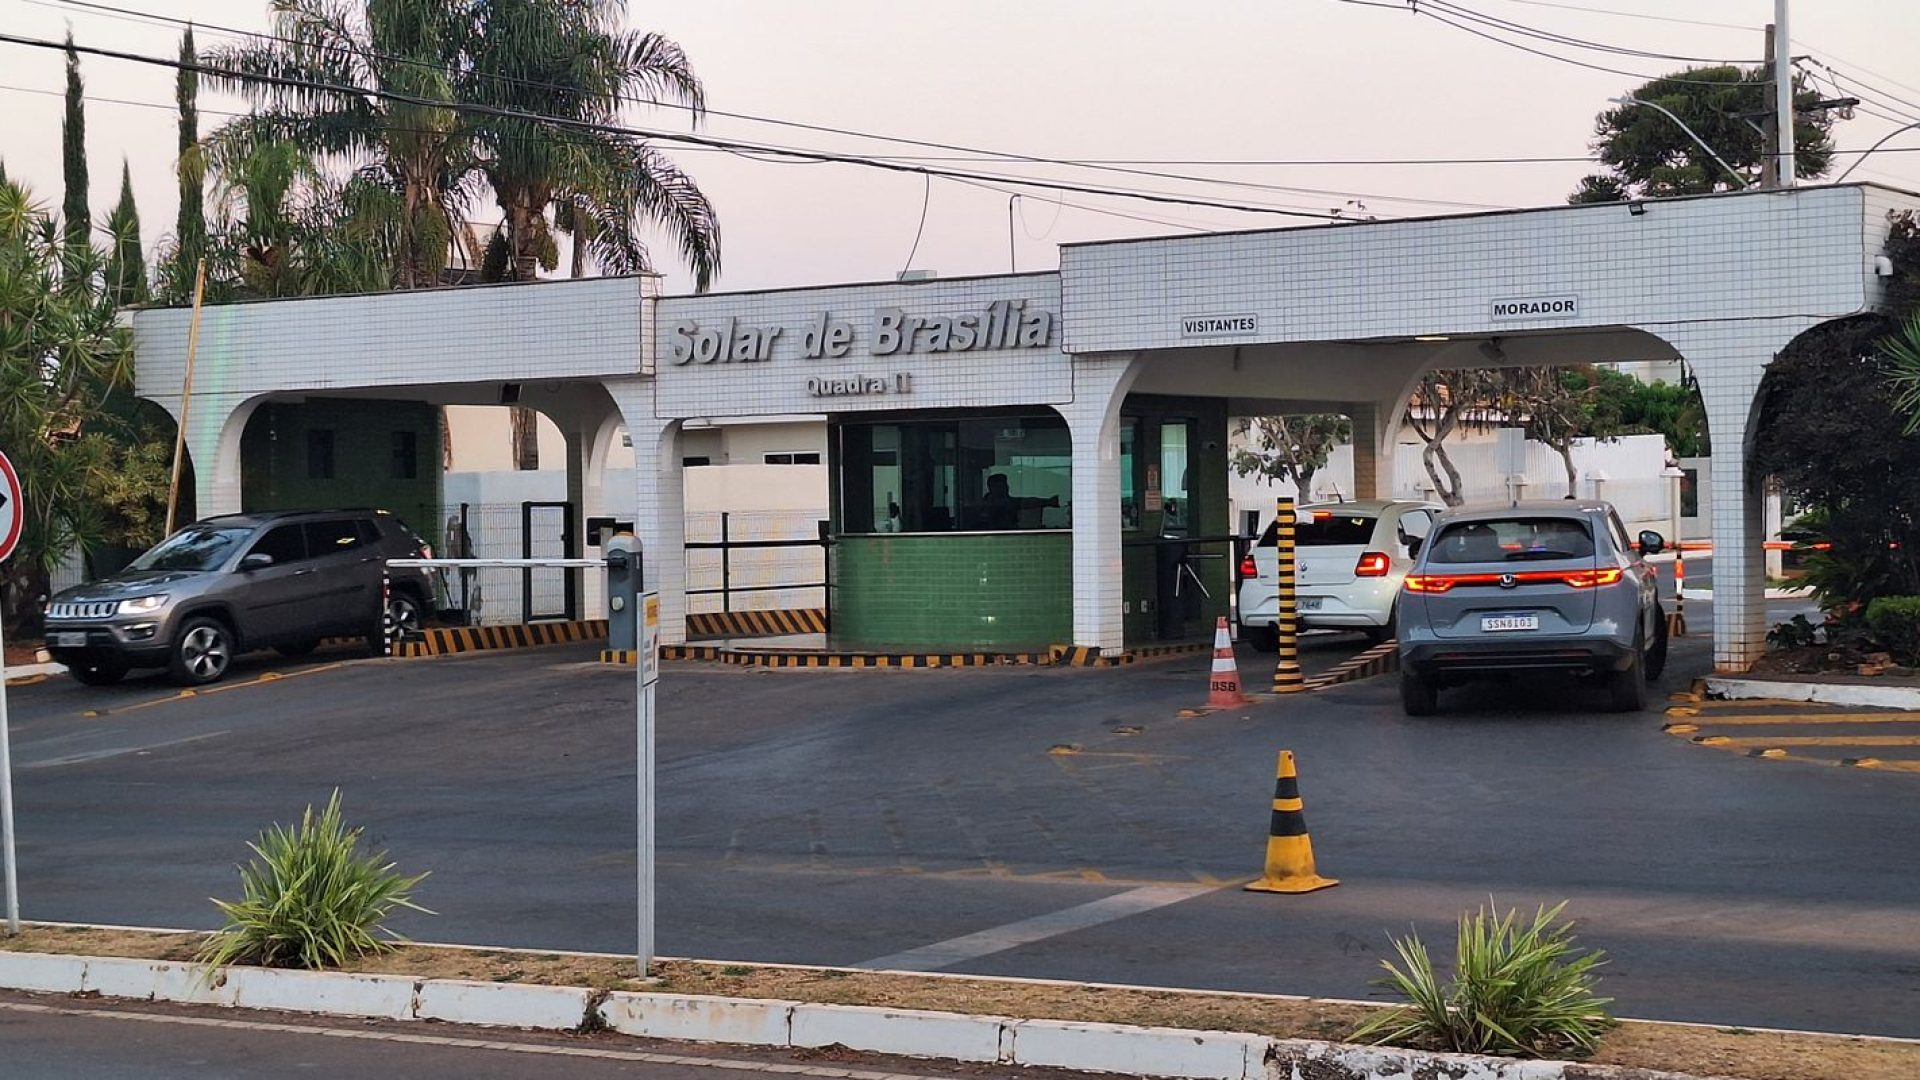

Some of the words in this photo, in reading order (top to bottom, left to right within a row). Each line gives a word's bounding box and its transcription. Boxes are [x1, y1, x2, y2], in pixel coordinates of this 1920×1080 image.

[1493, 300, 1575, 317] MORADOR
[671, 315, 783, 365] Solar
[800, 311, 853, 360] de
[871, 299, 1053, 356] Brasília
[1185, 318, 1255, 334] VISITANTES
[807, 374, 886, 397] Quadra
[1212, 682, 1237, 692] BSB
